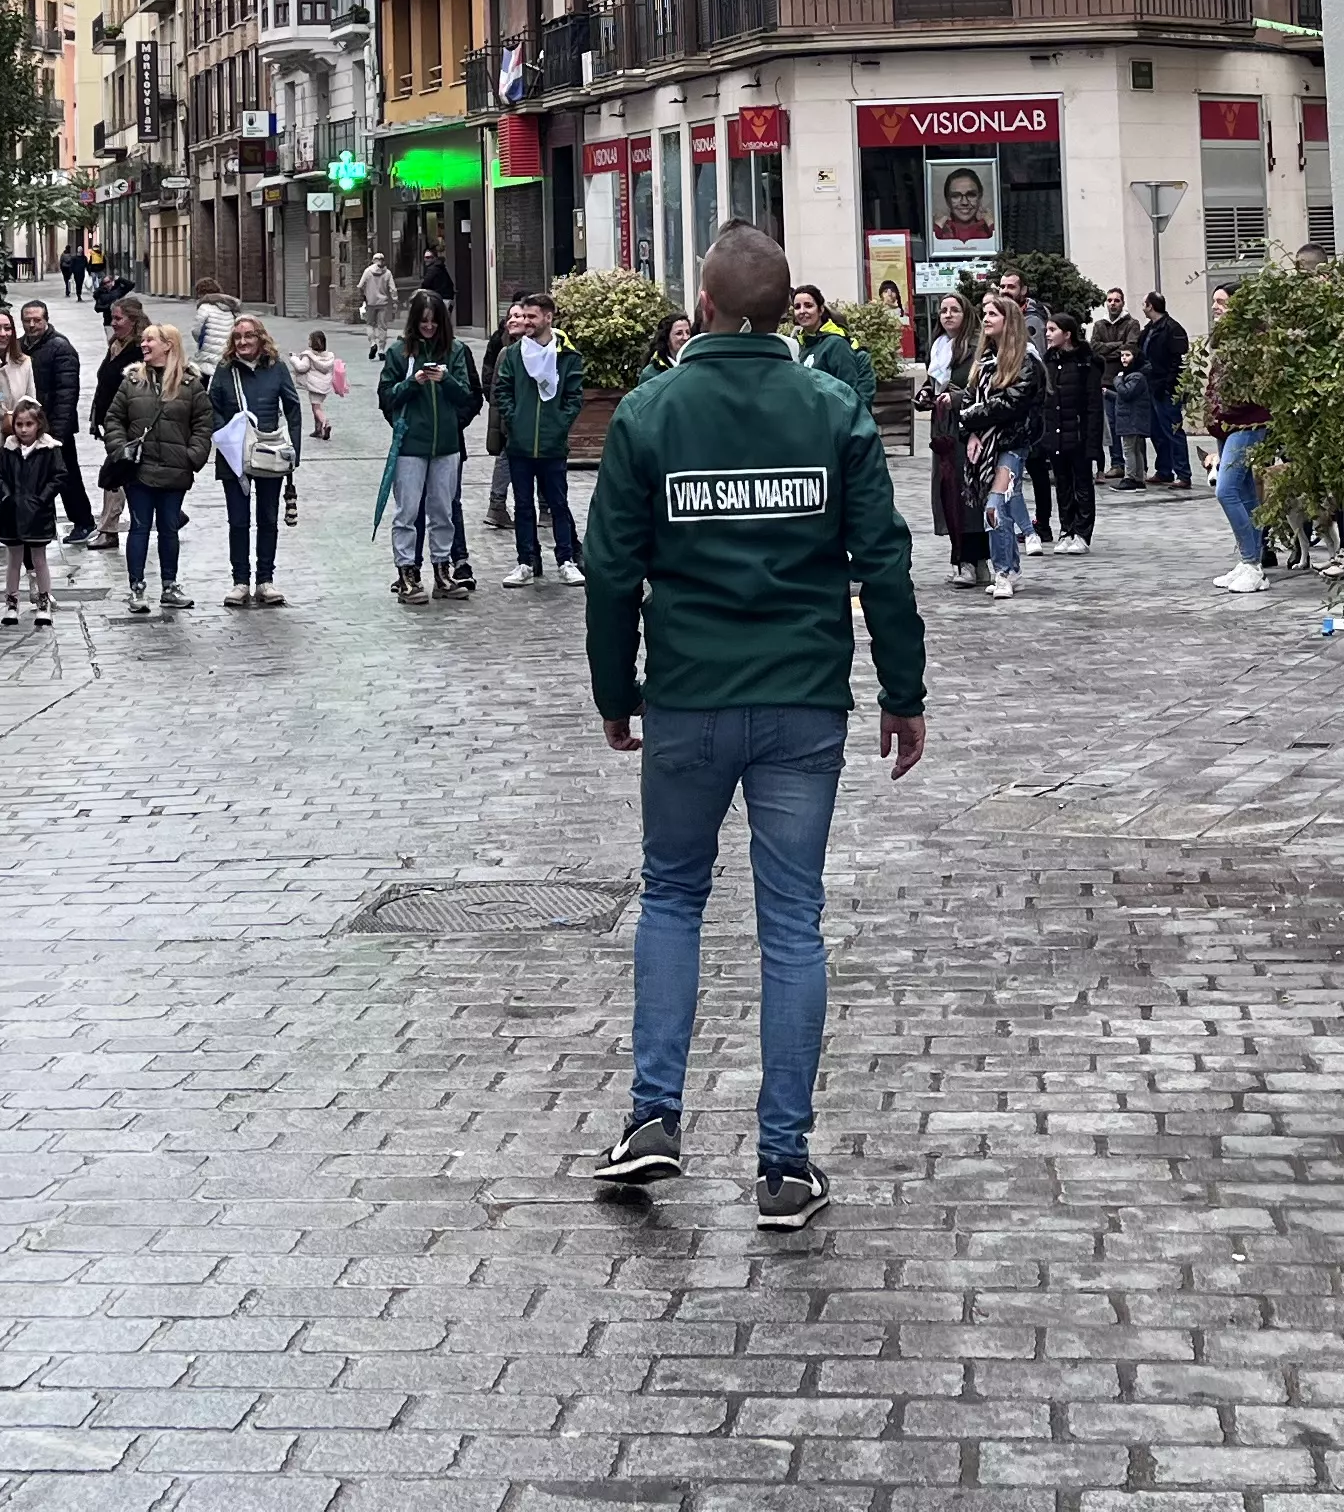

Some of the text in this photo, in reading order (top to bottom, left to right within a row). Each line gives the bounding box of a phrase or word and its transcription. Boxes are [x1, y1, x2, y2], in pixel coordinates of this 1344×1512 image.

[141, 43, 152, 133] Montovelaz
[909, 109, 1047, 135] VISIONLAB
[741, 140, 779, 150] VISIONLAB
[673, 478, 821, 510] VIVA SAN MARTIN
